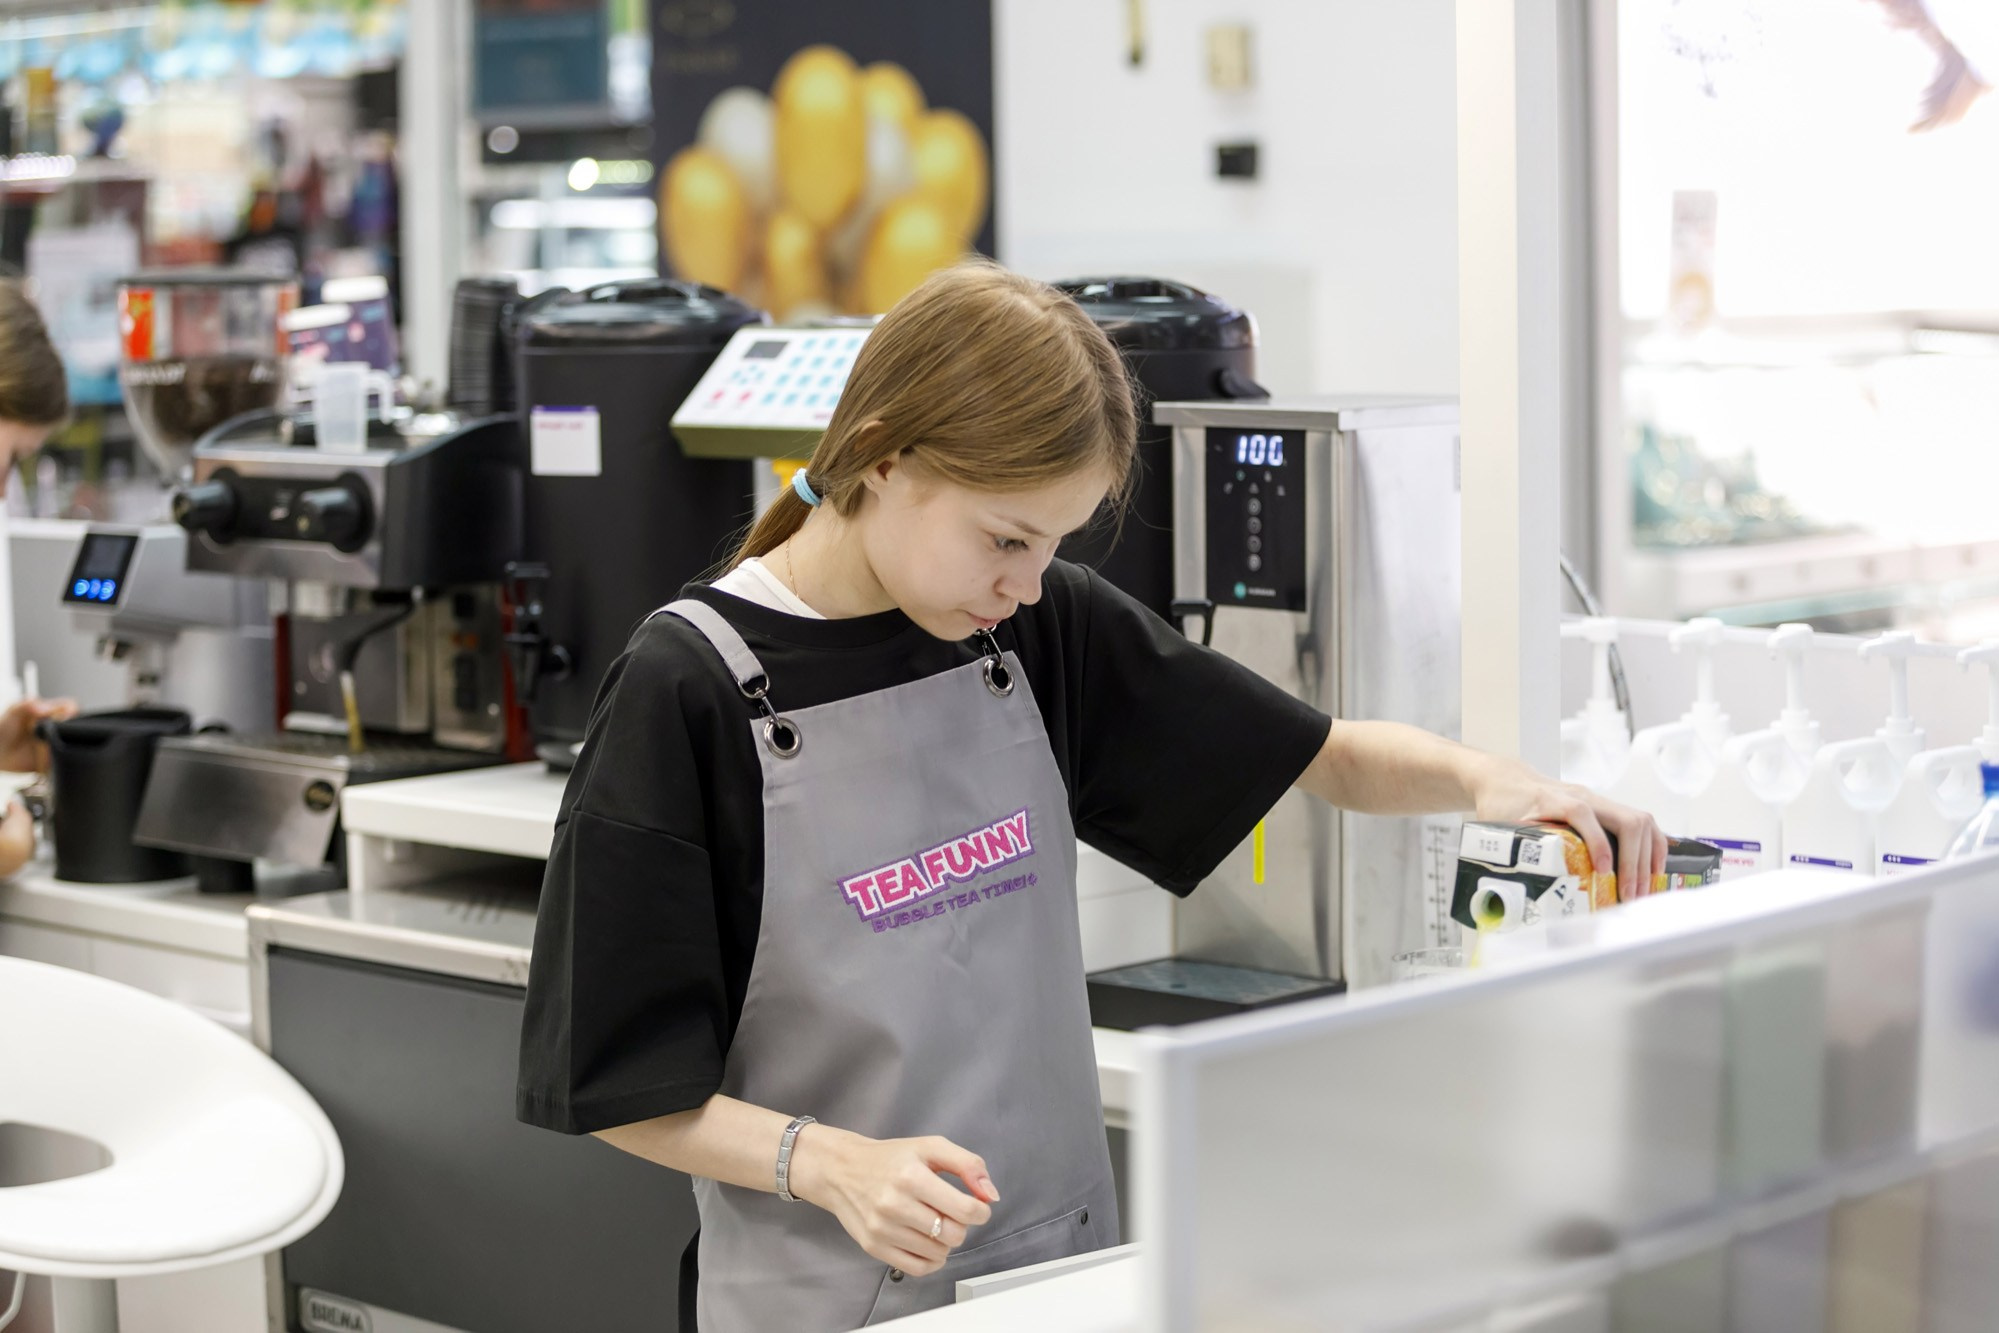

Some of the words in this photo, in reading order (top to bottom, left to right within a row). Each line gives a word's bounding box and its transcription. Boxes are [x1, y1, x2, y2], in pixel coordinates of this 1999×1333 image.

[1236, 434, 1284, 467] 100
[845, 859, 931, 915] TEA
[921, 811, 1031, 888] FUNNY
[872, 901, 946, 933] BUBBLE
[949, 889, 981, 911] TEA
